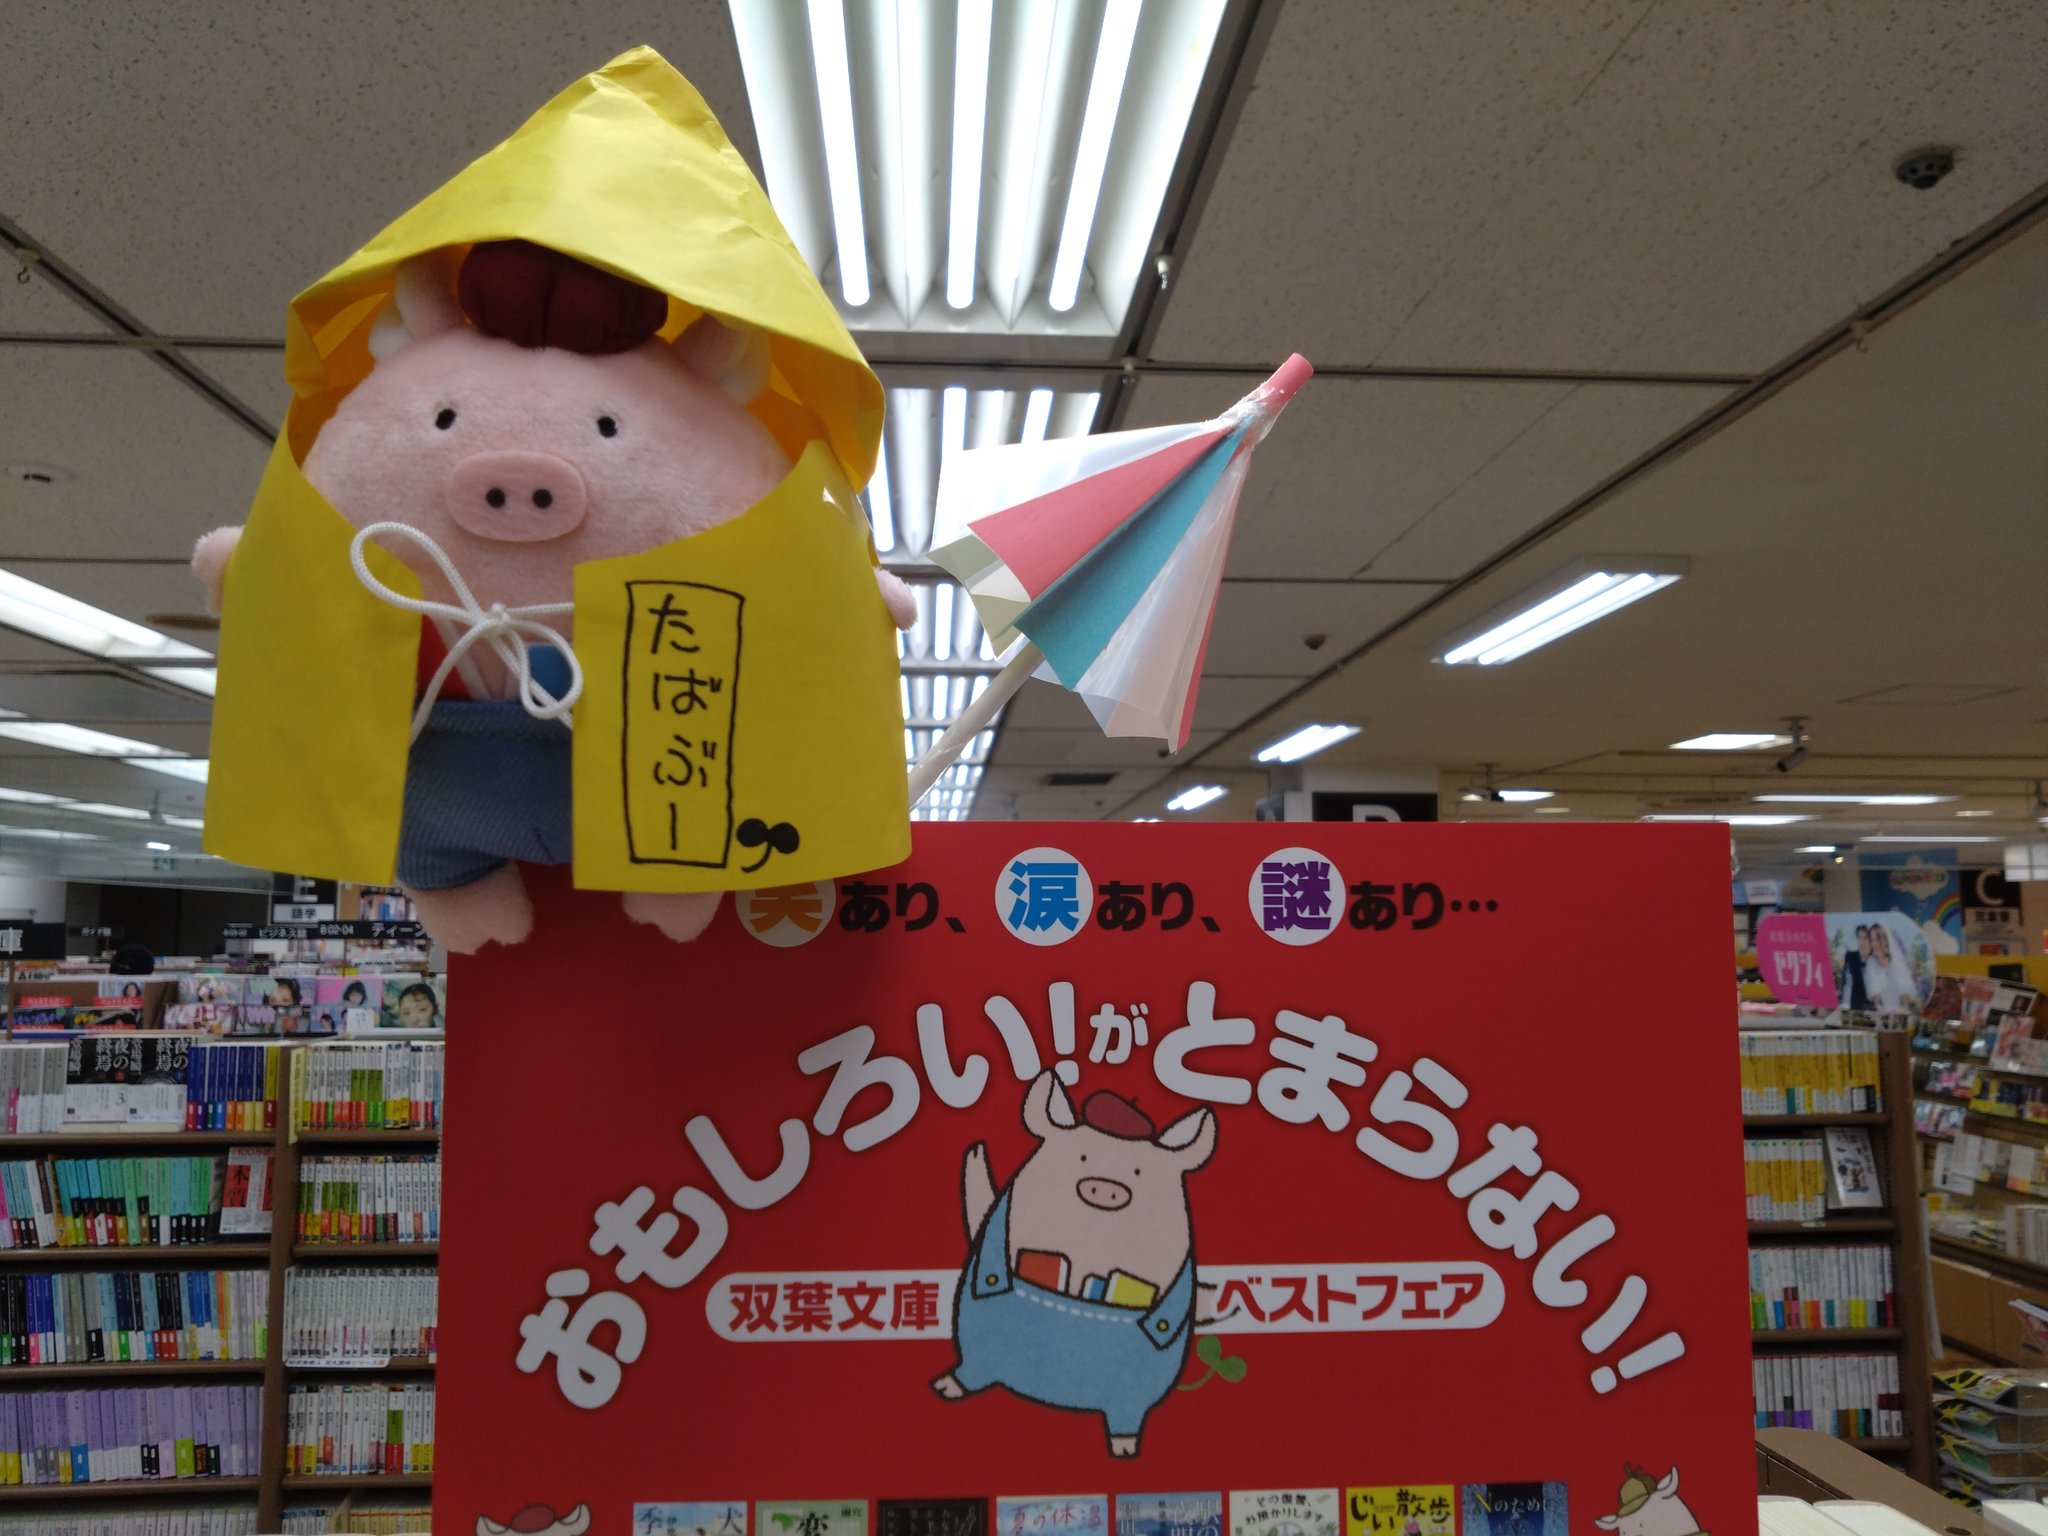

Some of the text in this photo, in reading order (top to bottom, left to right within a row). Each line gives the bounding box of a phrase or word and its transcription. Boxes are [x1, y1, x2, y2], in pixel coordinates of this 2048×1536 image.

[648, 593, 722, 850] たばぶー
[1976, 867, 2004, 906] C
[1773, 950, 1824, 988] ゼクシィ
[729, 1280, 940, 1332] 双葉文庫
[1217, 1272, 1484, 1323] ベストフェア
